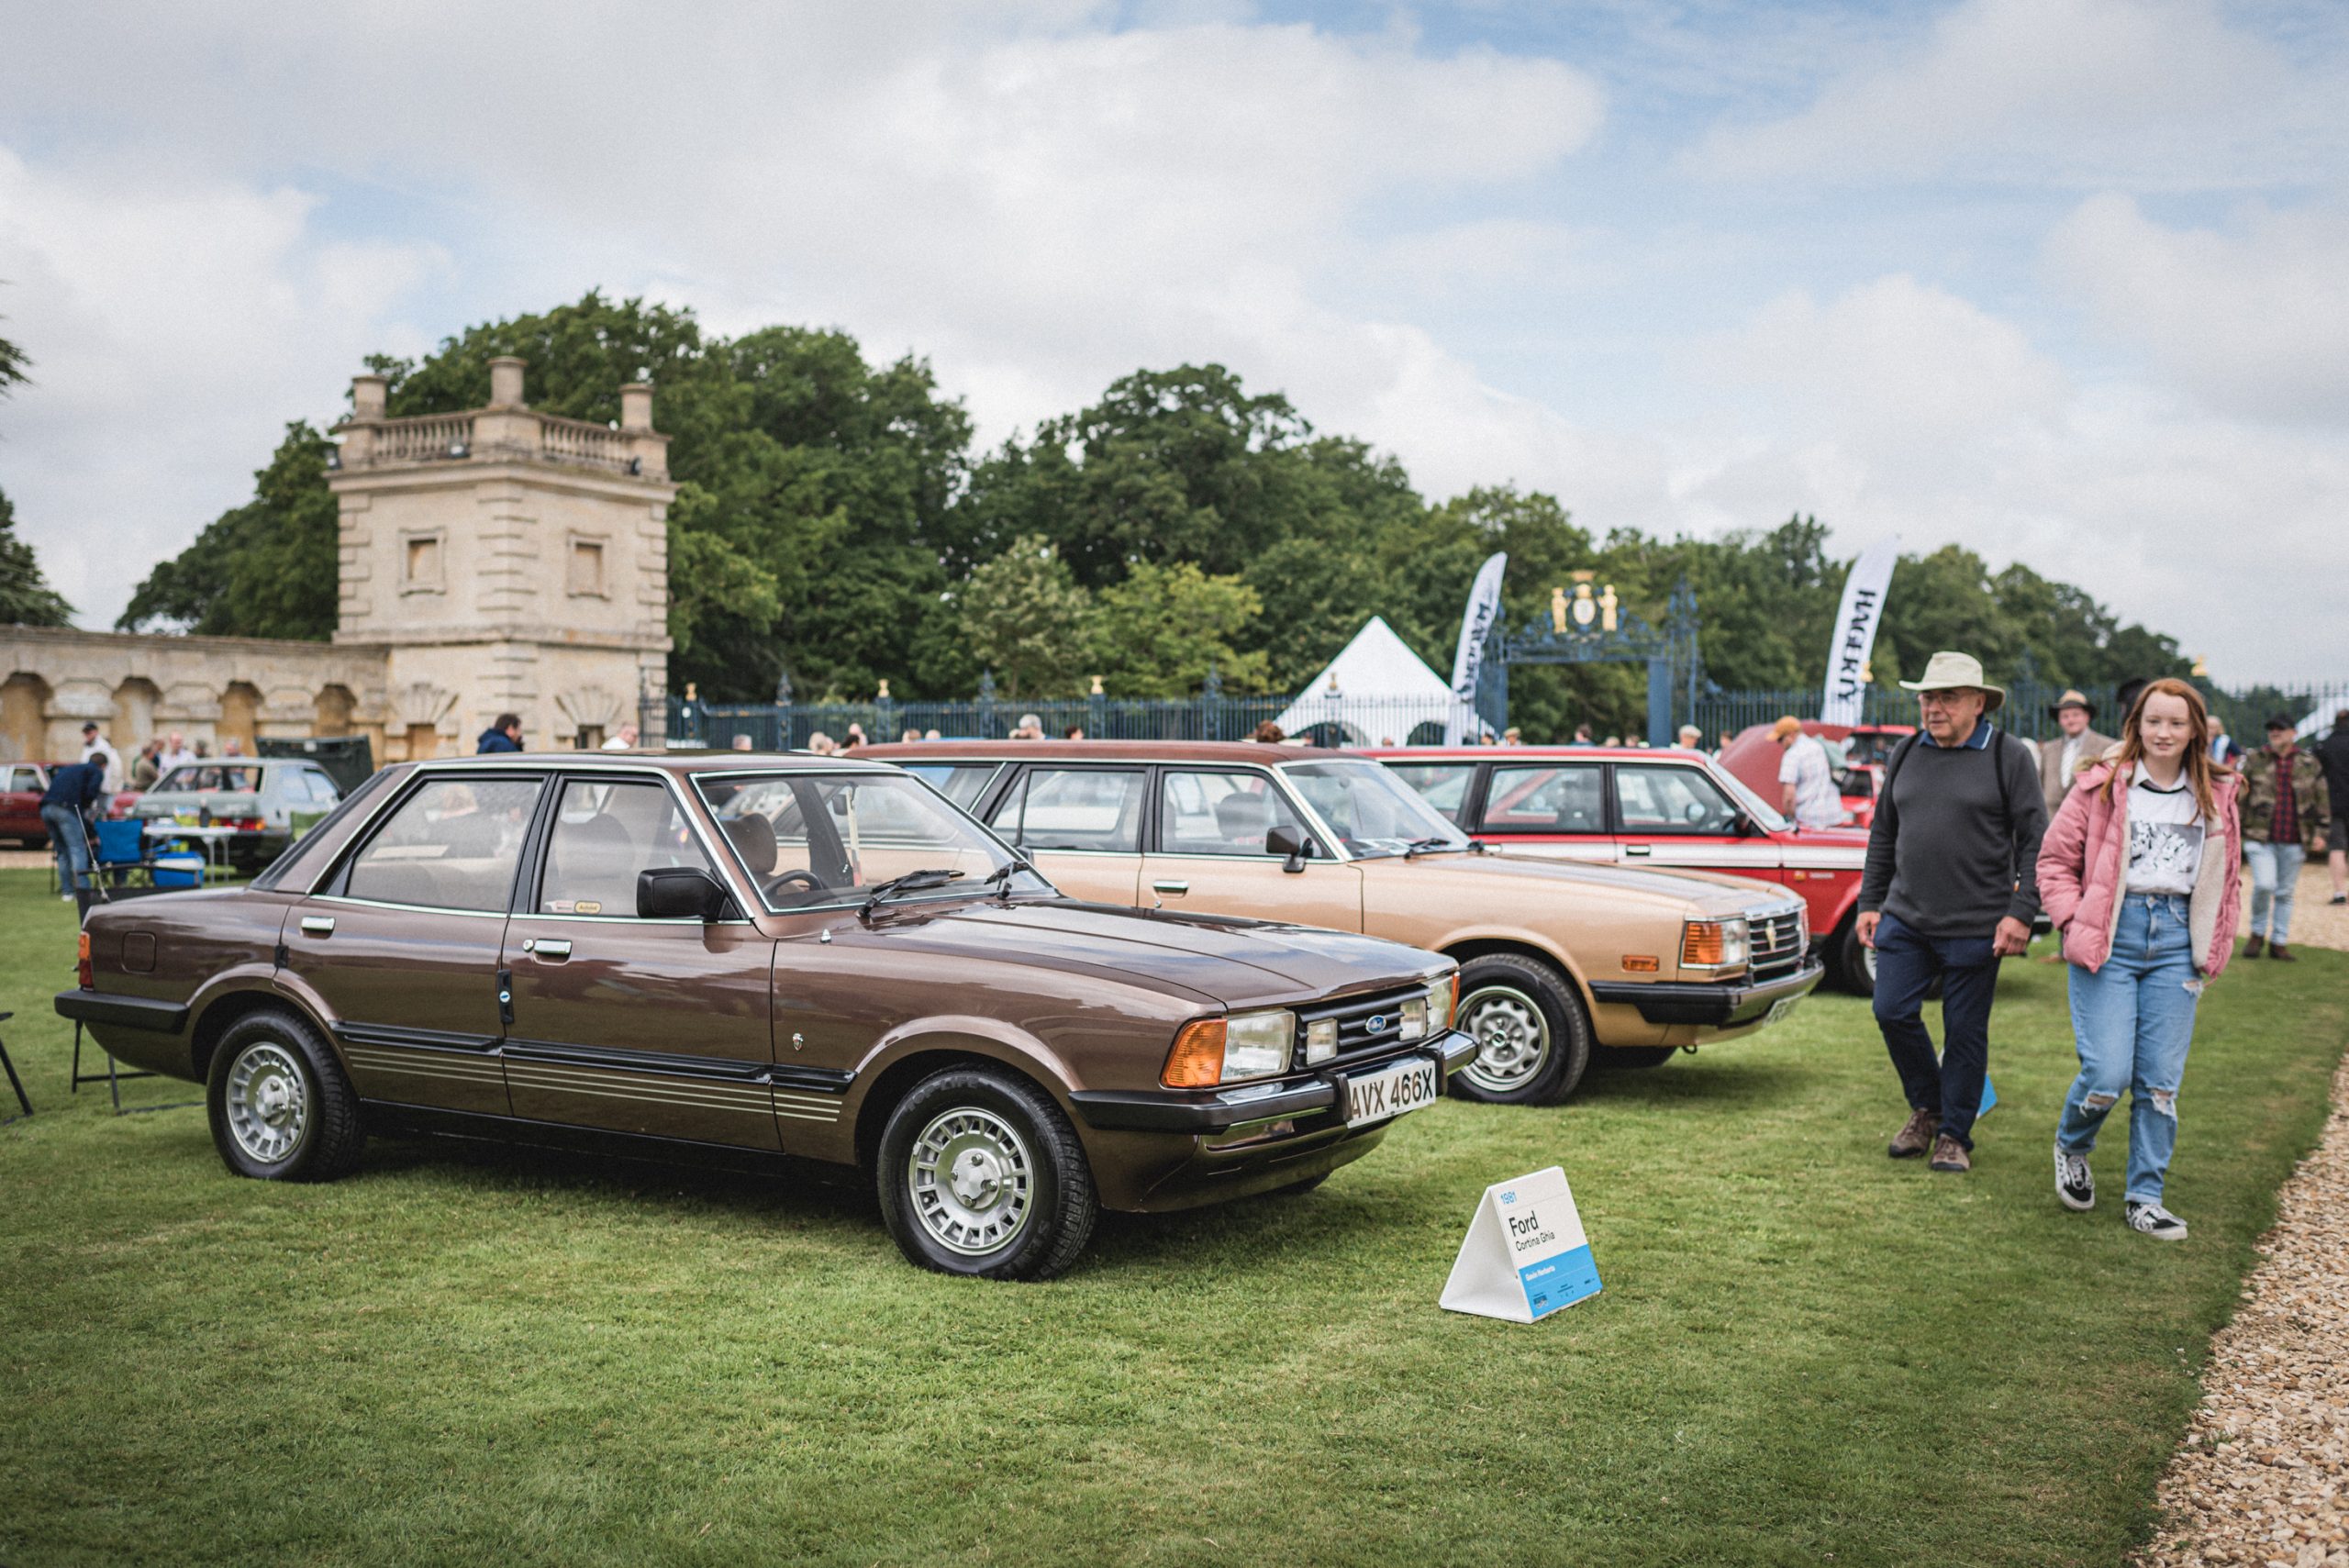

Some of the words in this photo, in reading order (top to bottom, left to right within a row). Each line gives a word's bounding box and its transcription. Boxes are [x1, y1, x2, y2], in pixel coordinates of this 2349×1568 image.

[1838, 589, 1876, 703] HAGERTY
[1352, 1080, 1384, 1118] AVX
[1390, 1068, 1432, 1107] 466X
[1500, 1191, 1517, 1205] 1981
[1508, 1210, 1539, 1237] Ford
[1516, 1237, 1541, 1251] Cortina
[1540, 1230, 1555, 1245] Ghia
